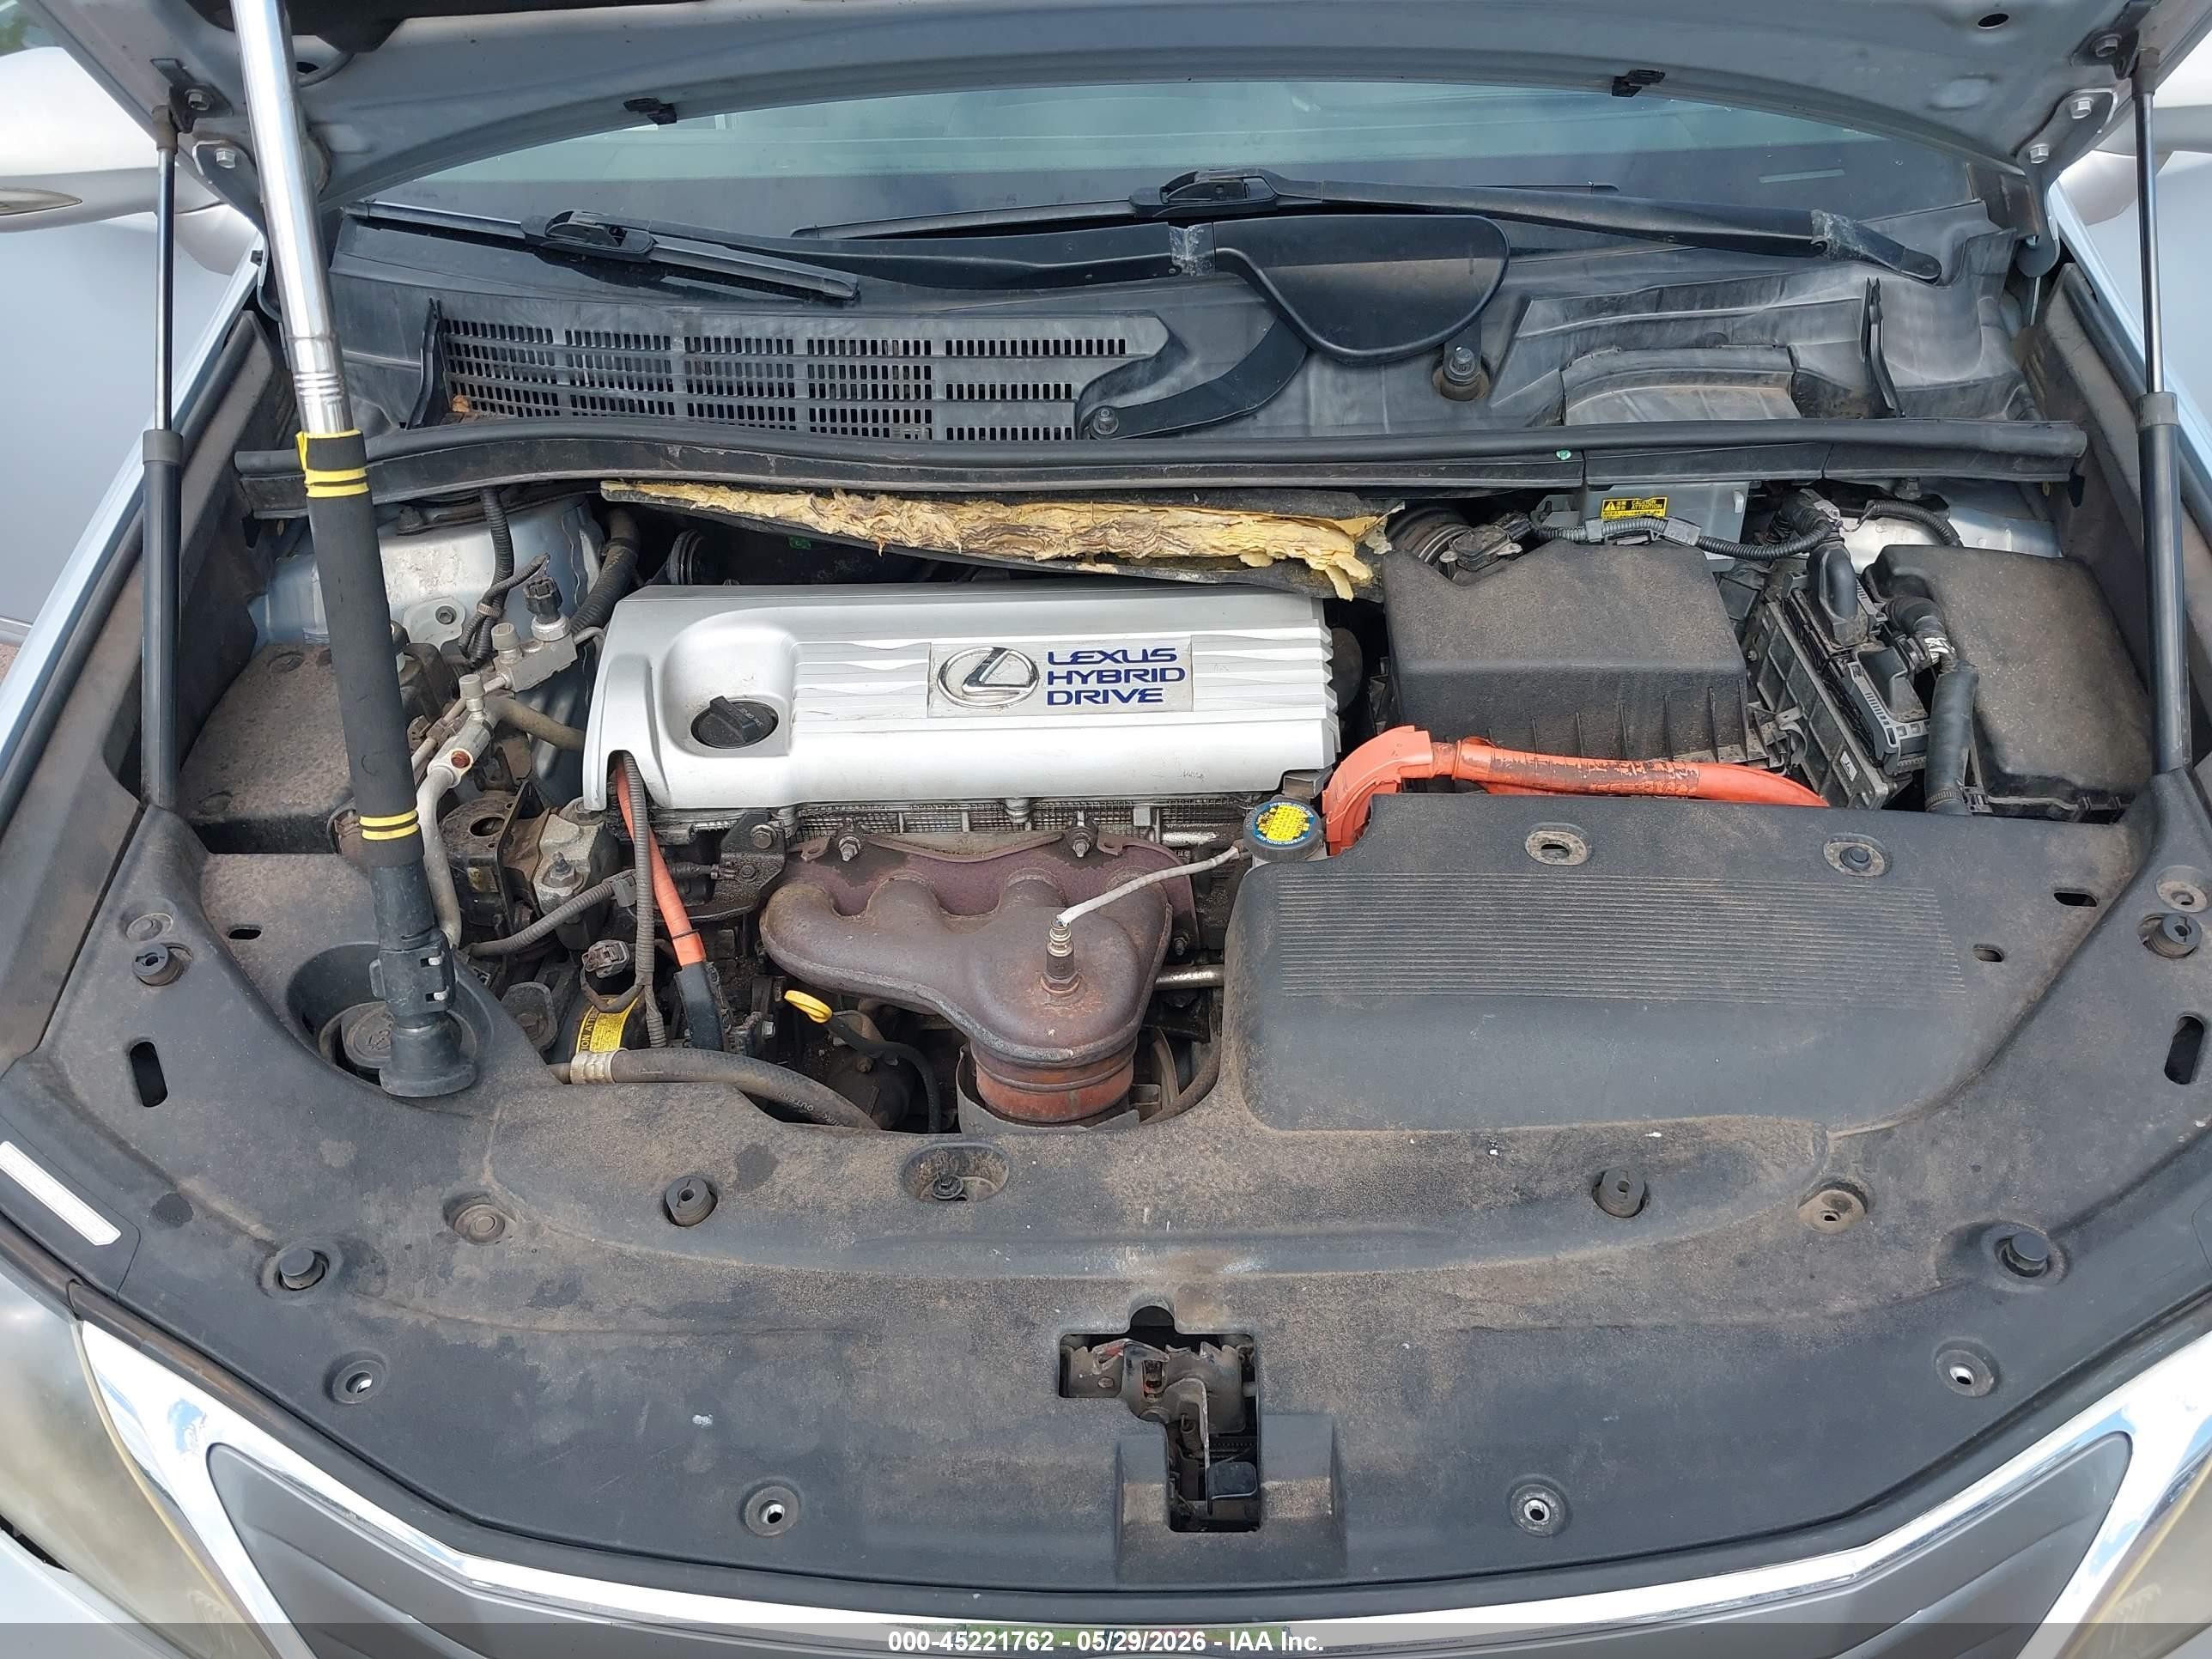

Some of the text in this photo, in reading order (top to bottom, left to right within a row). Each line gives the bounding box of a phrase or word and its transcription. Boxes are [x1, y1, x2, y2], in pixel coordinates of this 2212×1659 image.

[1047, 647, 1178, 665] LEXUS
[1047, 667, 1186, 685] HYBRID
[1047, 688, 1164, 706] DRIVE
